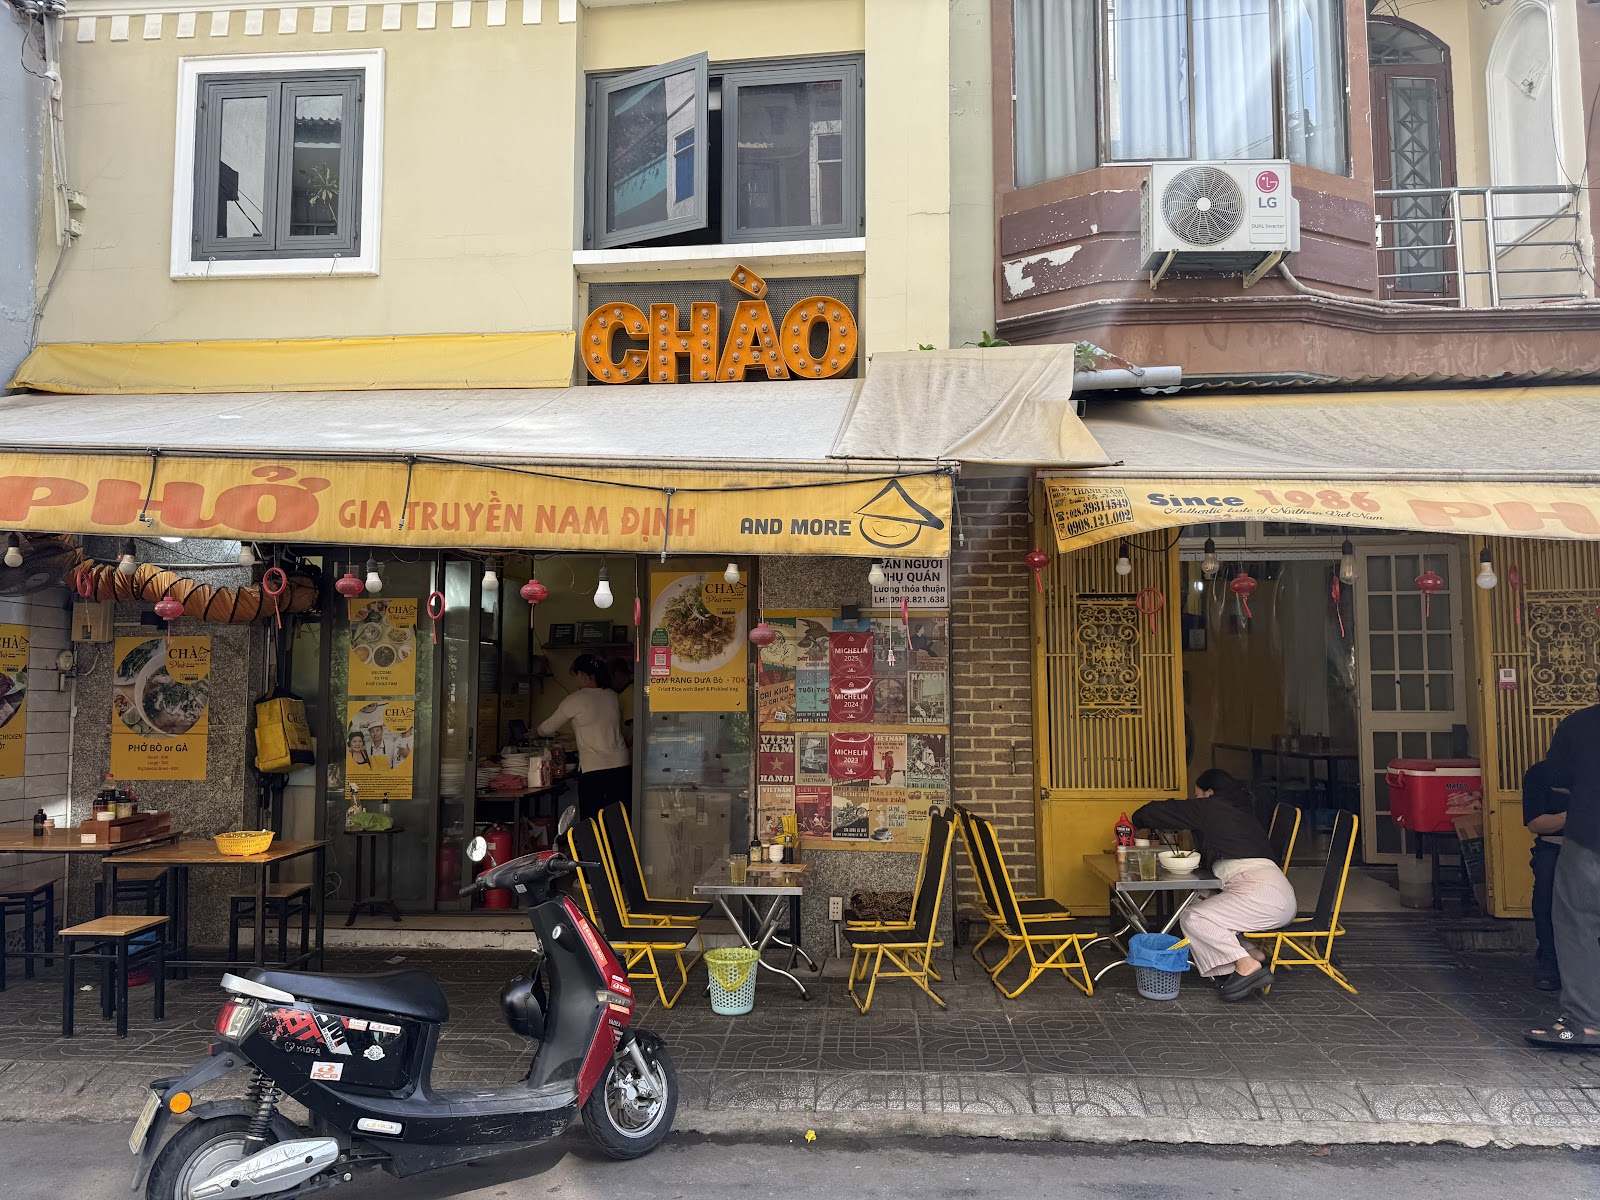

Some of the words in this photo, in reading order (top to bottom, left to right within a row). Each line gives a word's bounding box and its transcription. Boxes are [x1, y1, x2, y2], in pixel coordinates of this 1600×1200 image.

[1258, 197, 1277, 209] LG
[581, 264, 858, 384] CHÀO
[0, 465, 331, 534] PHỞ
[338, 499, 393, 530] GIA
[406, 491, 524, 533] TRUYỀN
[535, 504, 609, 537] NAM
[621, 505, 696, 543] ĐỊNH
[1146, 493, 1245, 507] Since
[1254, 489, 1381, 513] 1986
[740, 517, 783, 535] AND
[790, 518, 852, 537] MORE
[1067, 509, 1132, 536] 0908.121.002
[906, 570, 940, 583] QUÁN
[901, 585, 920, 593] thỏa
[921, 585, 946, 594] thuận
[874, 596, 888, 604] LH:
[890, 596, 945, 604] 09.821.638
[670, 676, 693, 684] RANG
[731, 676, 746, 684] 70K
[911, 672, 944, 681] HANOI
[760, 735, 794, 744] VIET
[128, 742, 149, 752] PHỞ
[149, 742, 163, 752] BÒ
[164, 744, 173, 752] or
[175, 742, 188, 752] GÀ
[759, 743, 794, 753] NAM
[843, 756, 859, 764] 2023
[759, 775, 794, 783] HANOI
[321, 1027, 336, 1051] RACING
[296, 1044, 321, 1056] YADEA
